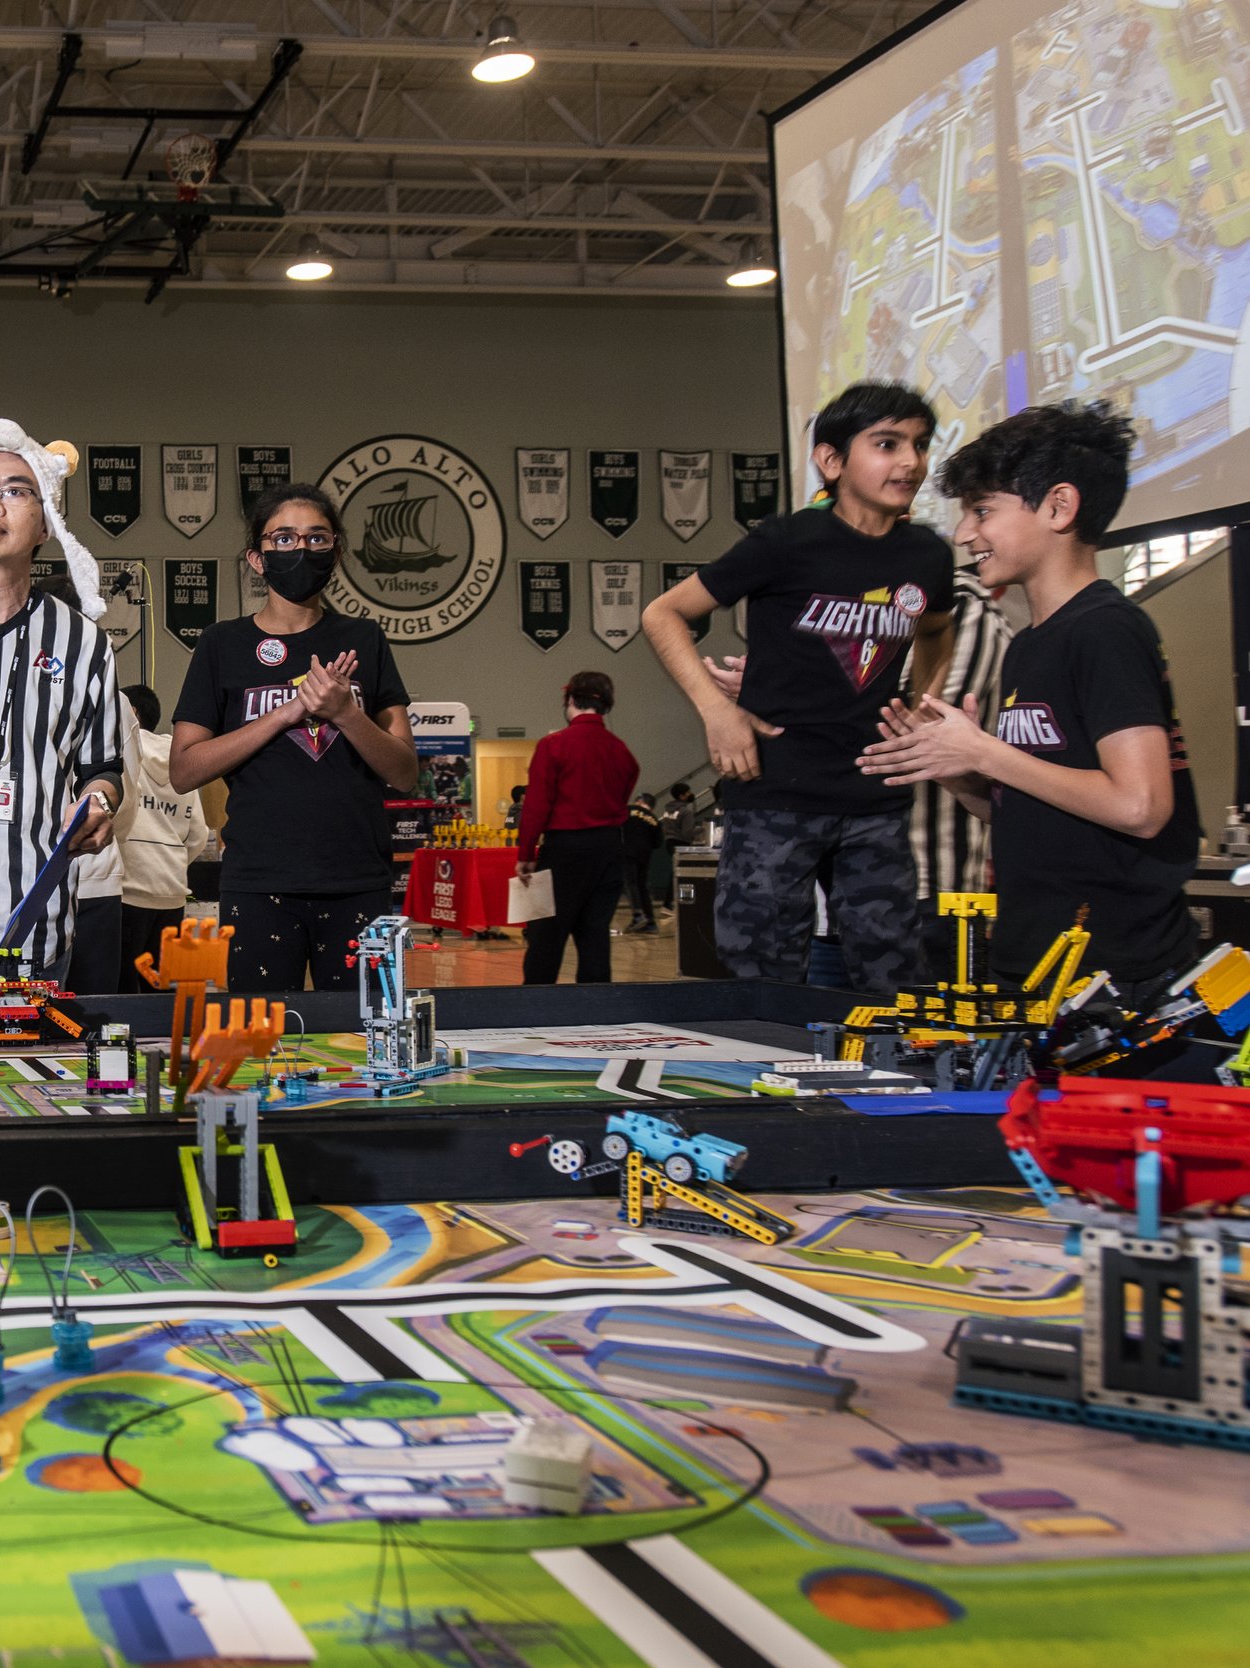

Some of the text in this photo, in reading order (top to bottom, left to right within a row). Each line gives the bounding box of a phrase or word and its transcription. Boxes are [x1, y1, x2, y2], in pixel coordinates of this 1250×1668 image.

[177, 450, 203, 460] GIRLS
[253, 450, 276, 461] BOYS
[531, 454, 556, 464] GIRLS
[93, 458, 136, 470] FOOTBALL
[165, 463, 215, 474] CROSS COUNTRY
[523, 467, 563, 477] SWIMMING
[593, 466, 636, 478] SWIMMING
[332, 446, 489, 510] ALO ALTO
[103, 514, 127, 523] CCS
[178, 515, 201, 523] CCS
[532, 517, 556, 526] CCS
[604, 517, 629, 526] CCS
[674, 519, 697, 527] CCS
[180, 563, 203, 574] BOYS
[534, 565, 557, 577] BOYS
[604, 565, 629, 575] GIRLS
[174, 575, 208, 586] SOCCER
[375, 577, 440, 595] Vikings
[326, 575, 371, 618] NIOR
[379, 616, 433, 634] HIGH
[437, 556, 495, 626] SCHOOL
[797, 598, 918, 639] LIGHTNIN
[535, 629, 559, 638] CCS
[605, 629, 628, 638] CCS
[260, 648, 282, 661] 56842
[861, 638, 874, 665] 6
[421, 715, 455, 725] FIRST
[433, 881, 456, 897] FIRST
[434, 895, 454, 909] LEGO
[430, 907, 457, 923] LEAGUE
